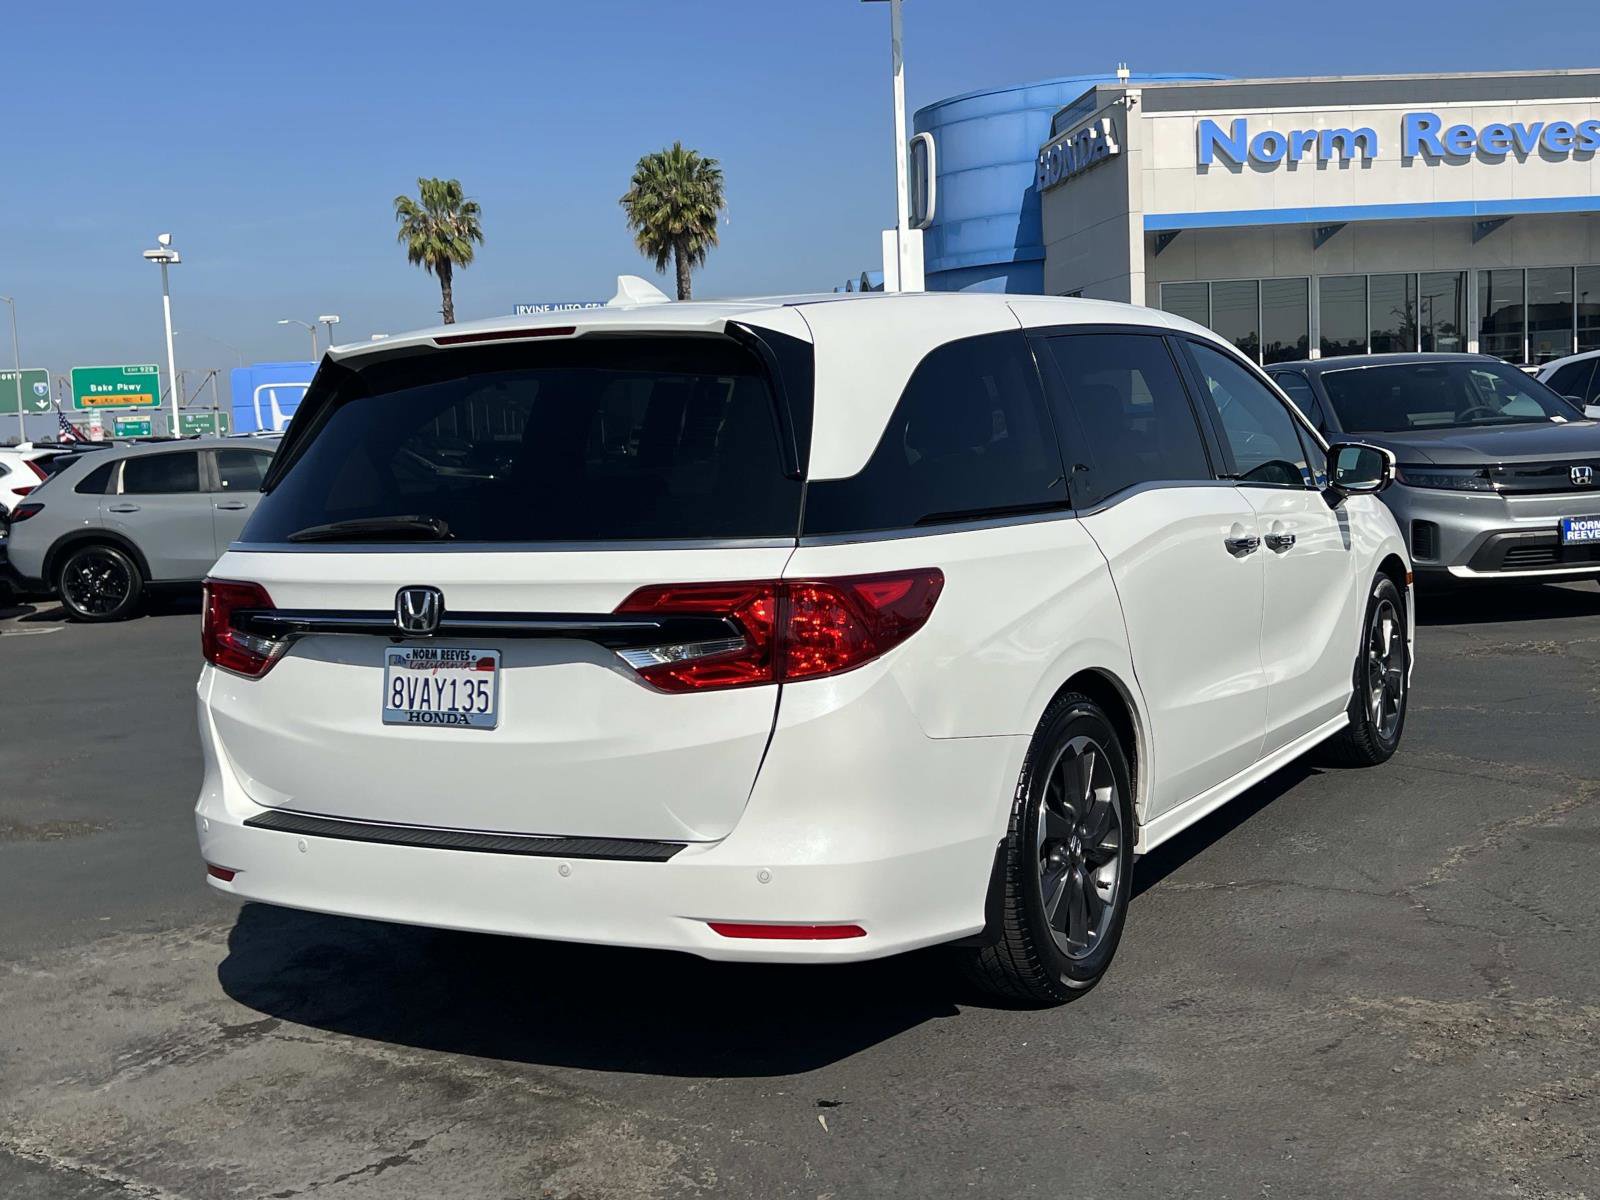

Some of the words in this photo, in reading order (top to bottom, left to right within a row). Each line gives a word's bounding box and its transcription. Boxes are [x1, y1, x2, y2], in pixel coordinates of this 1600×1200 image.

[1197, 118, 1378, 165] Norm
[1401, 112, 1600, 159] Reeves
[1036, 118, 1119, 192] HONDA
[516, 305, 550, 316] IRVINE
[553, 303, 581, 312] AUTO
[117, 383, 141, 391] Pkwy
[1567, 530, 1600, 540] REEVE
[412, 649, 437, 660] NORM
[441, 650, 470, 661] REEVES
[392, 676, 489, 713] 8VAY135
[407, 711, 471, 725] HONDA
